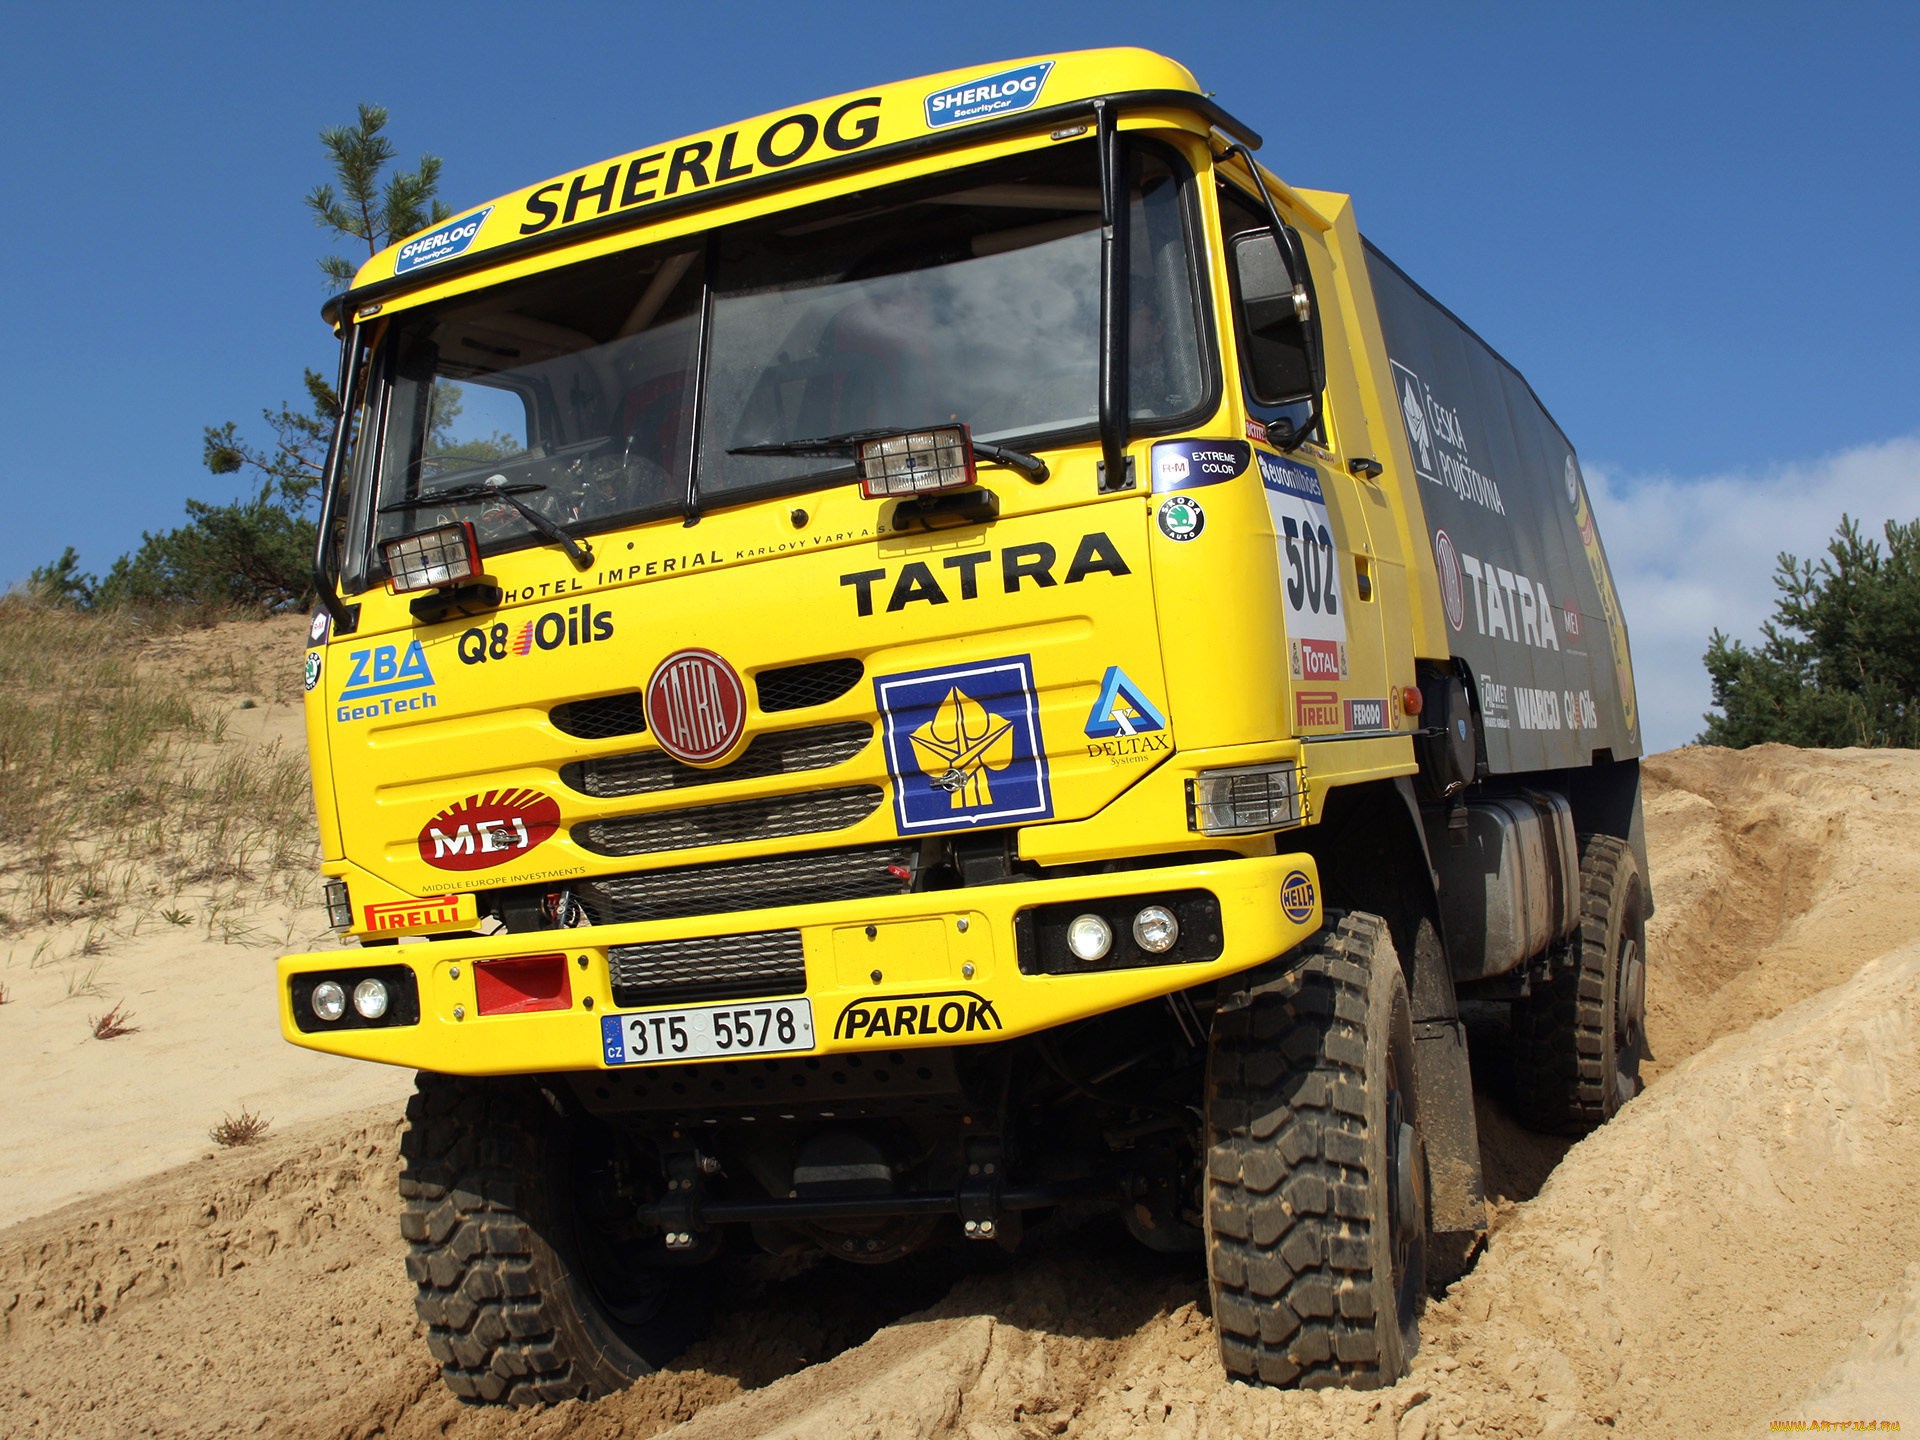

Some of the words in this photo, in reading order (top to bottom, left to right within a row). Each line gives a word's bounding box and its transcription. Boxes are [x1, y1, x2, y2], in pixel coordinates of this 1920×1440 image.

[932, 76, 1037, 112] SHERLOG
[954, 100, 1012, 118] SecurityCar
[519, 96, 882, 235] SHERLOG
[401, 222, 477, 260] SHERLOG
[413, 246, 454, 264] SecurityCar
[1424, 382, 1468, 453] ČESKÁ
[1162, 463, 1186, 473] R-M
[1192, 451, 1237, 464] EXTREME
[1202, 463, 1235, 475] COLOR
[1168, 531, 1196, 540] AUTO
[504, 577, 583, 604] HOTEL
[598, 551, 724, 585] IMPERIAL
[736, 540, 807, 560] KARLOVY
[814, 531, 855, 545] VARY
[840, 532, 1132, 617] TATRA
[1282, 515, 1337, 616] 502
[1462, 553, 1560, 651] TATRA
[458, 622, 509, 665] Q8
[535, 603, 614, 650] Oils
[1563, 610, 1579, 635] MEI
[345, 640, 436, 688] ZBA
[1303, 645, 1339, 673] TOTAL
[337, 692, 437, 722] GeoTech
[660, 659, 727, 752] TATRA
[1296, 691, 1339, 726] PIRELLI
[1353, 704, 1381, 725] FERODO
[1514, 686, 1561, 730] WABCO
[1579, 690, 1598, 729] Oils
[1086, 734, 1170, 758] DELTAX
[1110, 755, 1149, 768] Systems
[429, 817, 529, 859] MEI
[422, 881, 463, 893] MIDDLE
[465, 876, 508, 888] EUROPE
[510, 866, 586, 882] INVESTMENTS
[1282, 882, 1315, 908] HELLA
[363, 895, 459, 932] PIRELLI
[628, 1014, 689, 1056] 3T5
[712, 1007, 797, 1050] 5578
[845, 999, 994, 1039] PARLOK
[607, 1046, 624, 1058] CZ
